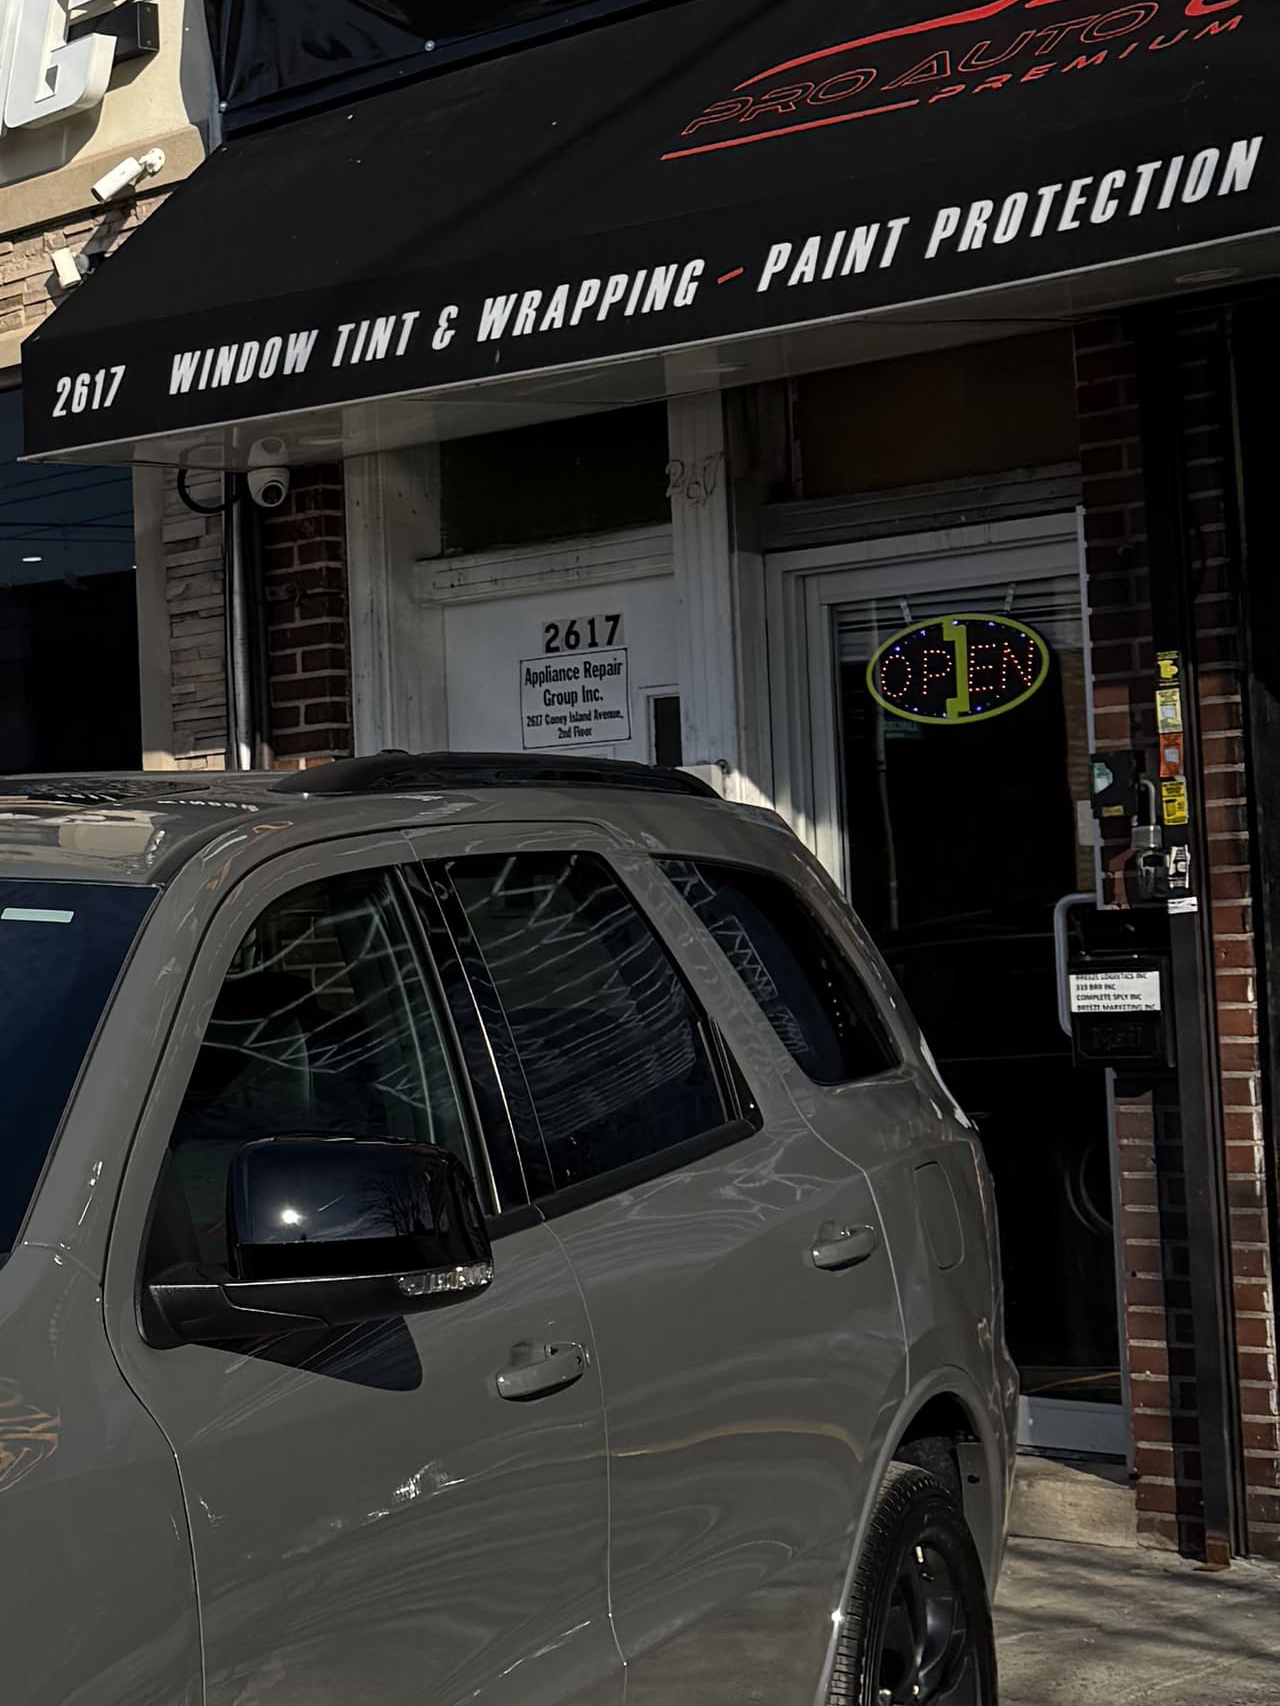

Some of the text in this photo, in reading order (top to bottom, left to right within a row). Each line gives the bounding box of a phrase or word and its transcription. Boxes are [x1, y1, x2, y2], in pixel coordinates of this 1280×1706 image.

[681, 68, 877, 136] PRO
[881, 1, 1159, 91] AUTO
[928, 14, 1243, 104] PREMIUM
[53, 363, 127, 418] 2617
[168, 329, 318, 397] WINDOW
[329, 307, 420, 369] TINT
[432, 304, 457, 350] &
[476, 257, 708, 344] WRAPPING
[756, 215, 910, 293] PAINT
[924, 133, 1265, 261] PROTECTION
[544, 613, 621, 654] 2617
[525, 657, 623, 689] Appliance Repair
[880, 637, 1036, 700] OPEN
[543, 684, 604, 707] Group Inc.
[569, 709, 592, 723] Island
[573, 725, 593, 739] Floor
